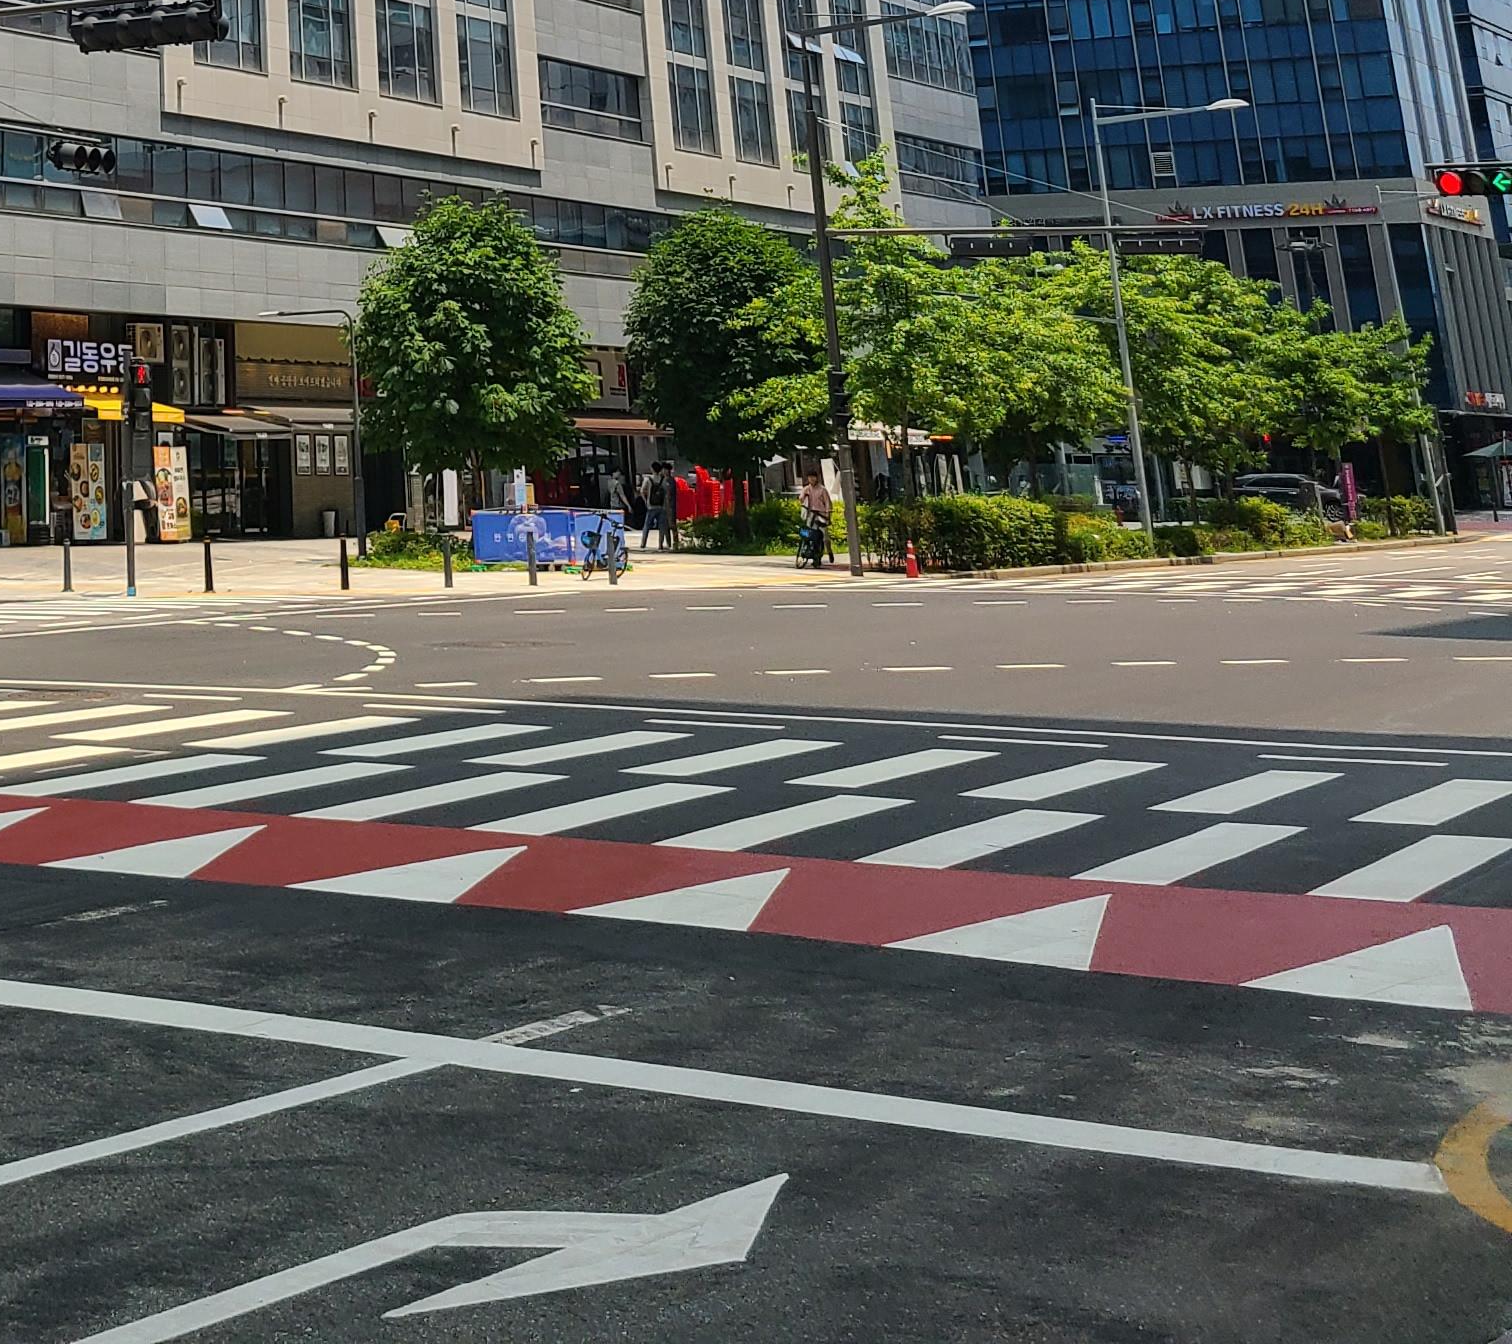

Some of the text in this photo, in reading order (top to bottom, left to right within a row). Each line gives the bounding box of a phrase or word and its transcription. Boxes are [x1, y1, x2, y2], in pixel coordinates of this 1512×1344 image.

[1192, 206, 1214, 220] LX
[1216, 203, 1284, 219] FITNESS
[1288, 203, 1324, 217] 24H
